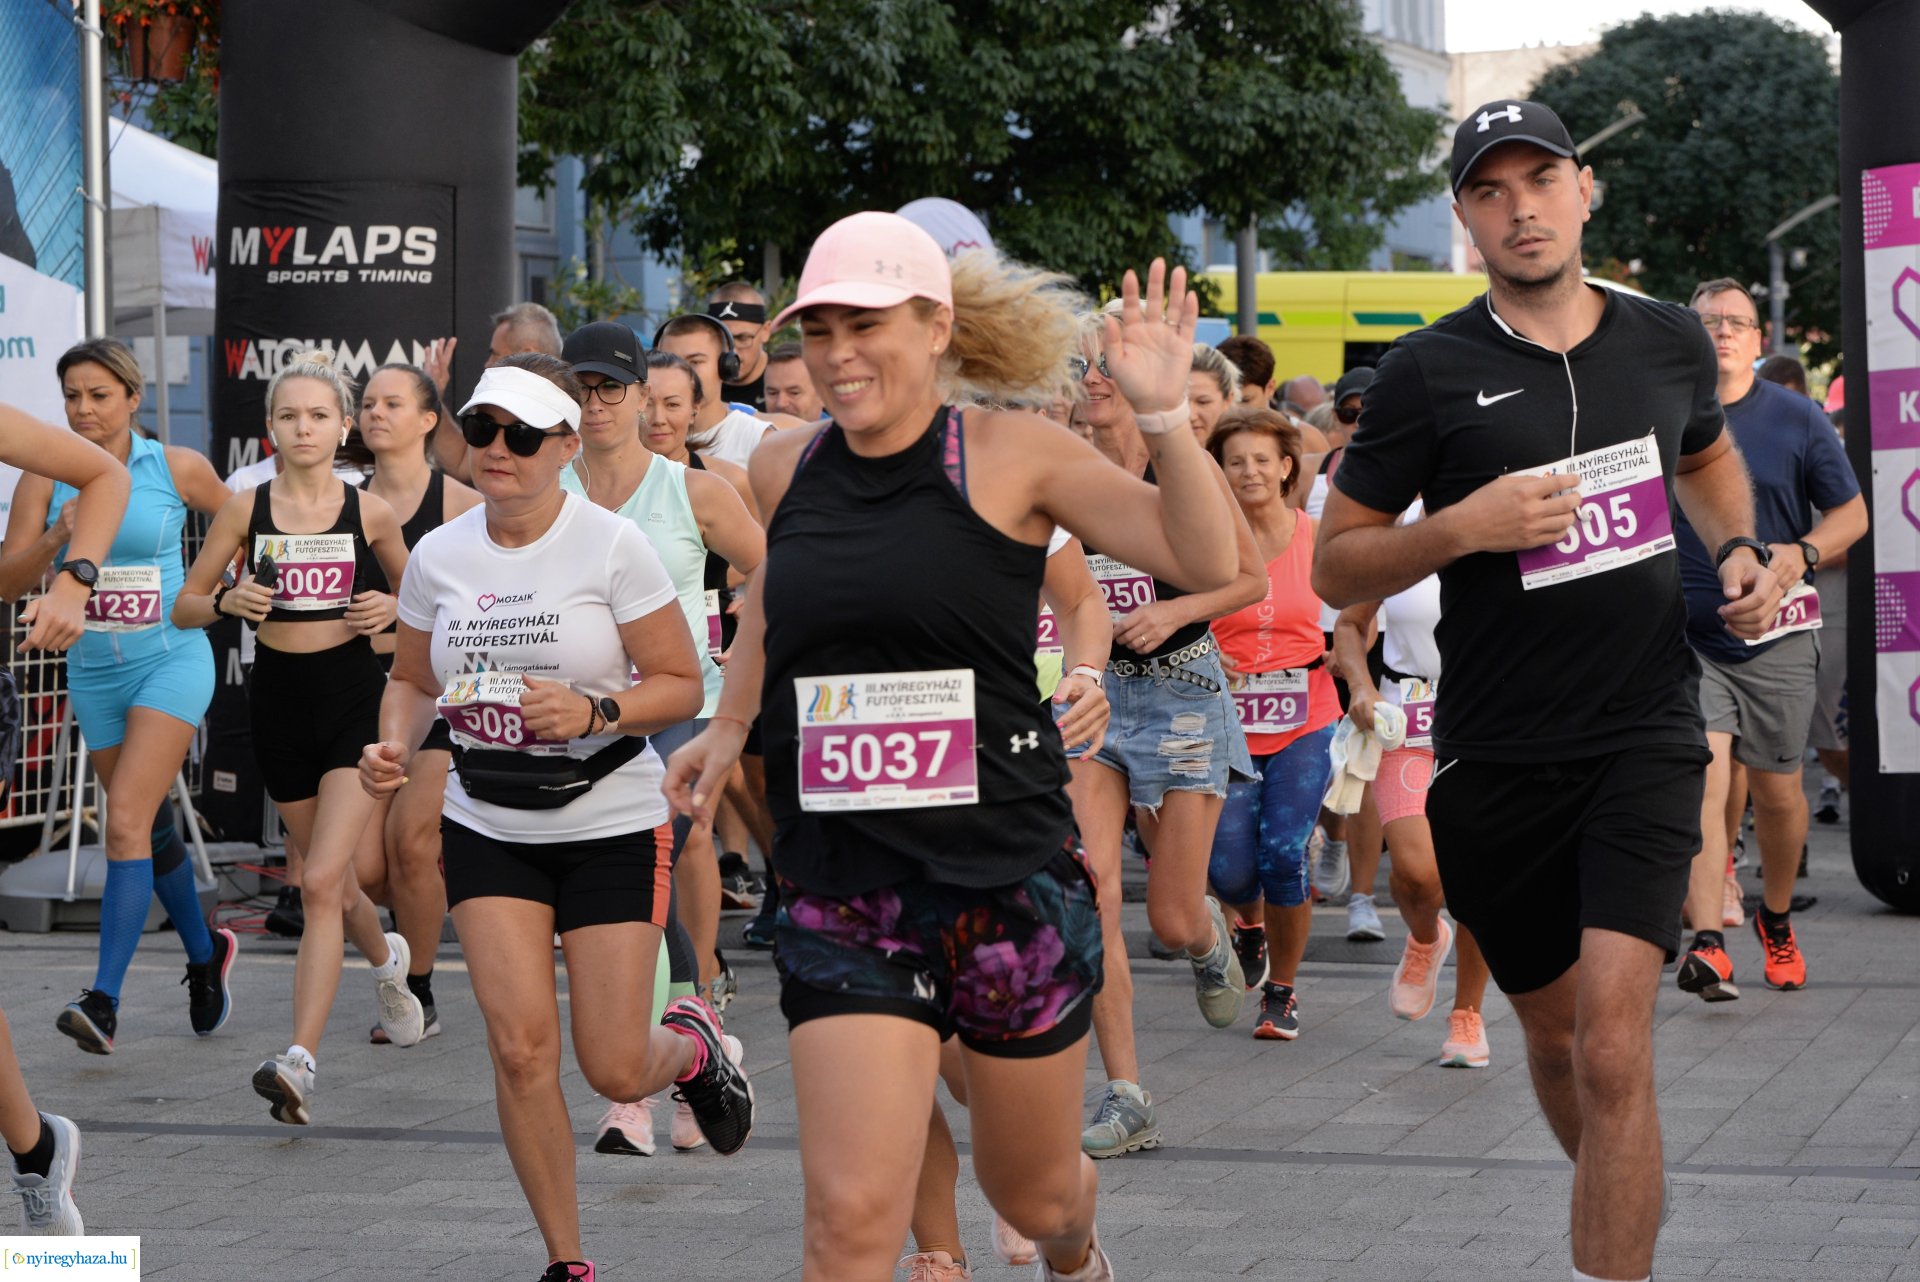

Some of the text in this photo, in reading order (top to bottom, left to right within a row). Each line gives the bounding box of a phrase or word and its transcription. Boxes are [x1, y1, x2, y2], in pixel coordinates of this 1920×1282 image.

[230, 226, 438, 265] MYLAPS
[267, 270, 433, 283] SPORTS TIMING
[224, 338, 439, 380] WATCMAN
[1579, 454, 1651, 482] TÓFESZTIVÁL
[273, 567, 342, 595] 5002
[85, 594, 158, 619] 1237
[496, 593, 533, 604] MOZAIK
[447, 611, 560, 631] III. NYÍREGYHÁZI
[447, 629, 559, 648] FUTÓFESZTIVÁL
[503, 663, 560, 672] támogatásával
[866, 692, 961, 706] FUTÓFESZTIVÁL
[1233, 697, 1297, 721] 5129
[460, 706, 541, 745] 508
[820, 730, 952, 783] 5037
